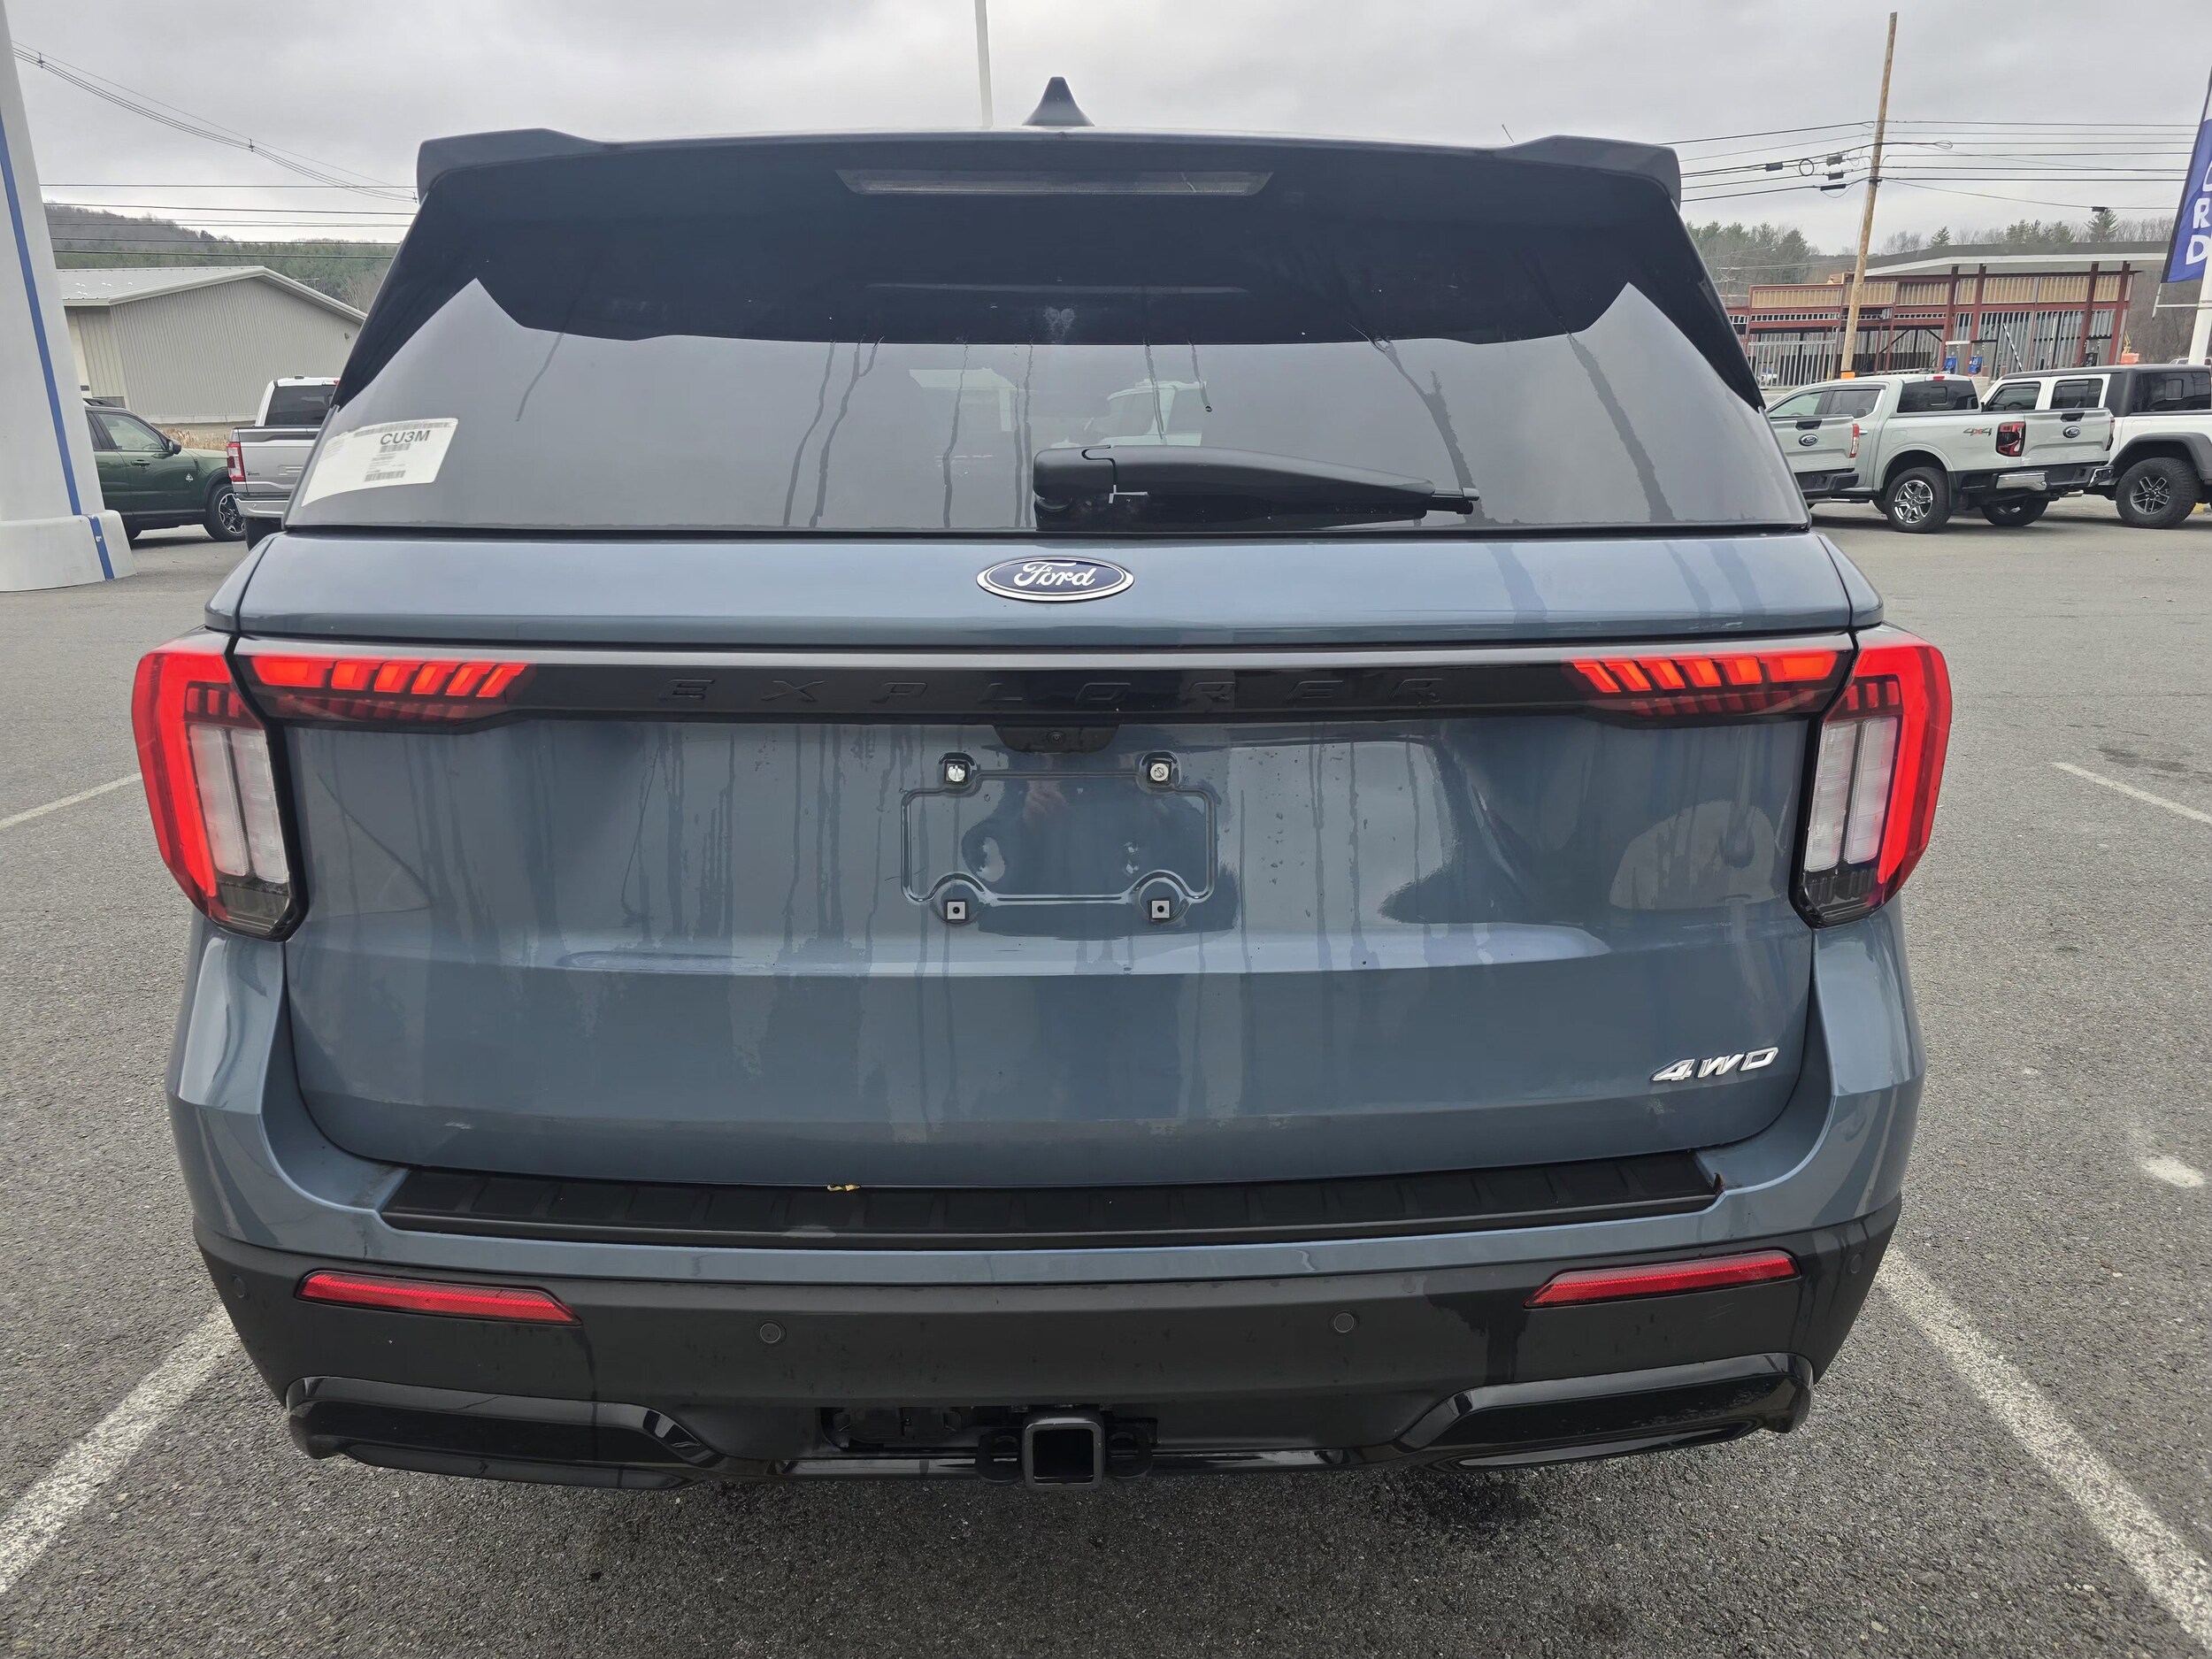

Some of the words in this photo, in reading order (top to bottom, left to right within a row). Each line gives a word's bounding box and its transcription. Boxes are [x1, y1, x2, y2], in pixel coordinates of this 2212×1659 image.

[380, 430, 431, 445] CU3M
[1013, 561, 1097, 587] Ford
[658, 678, 1444, 703] EXPLORER
[1650, 1047, 1778, 1081] 4WD
